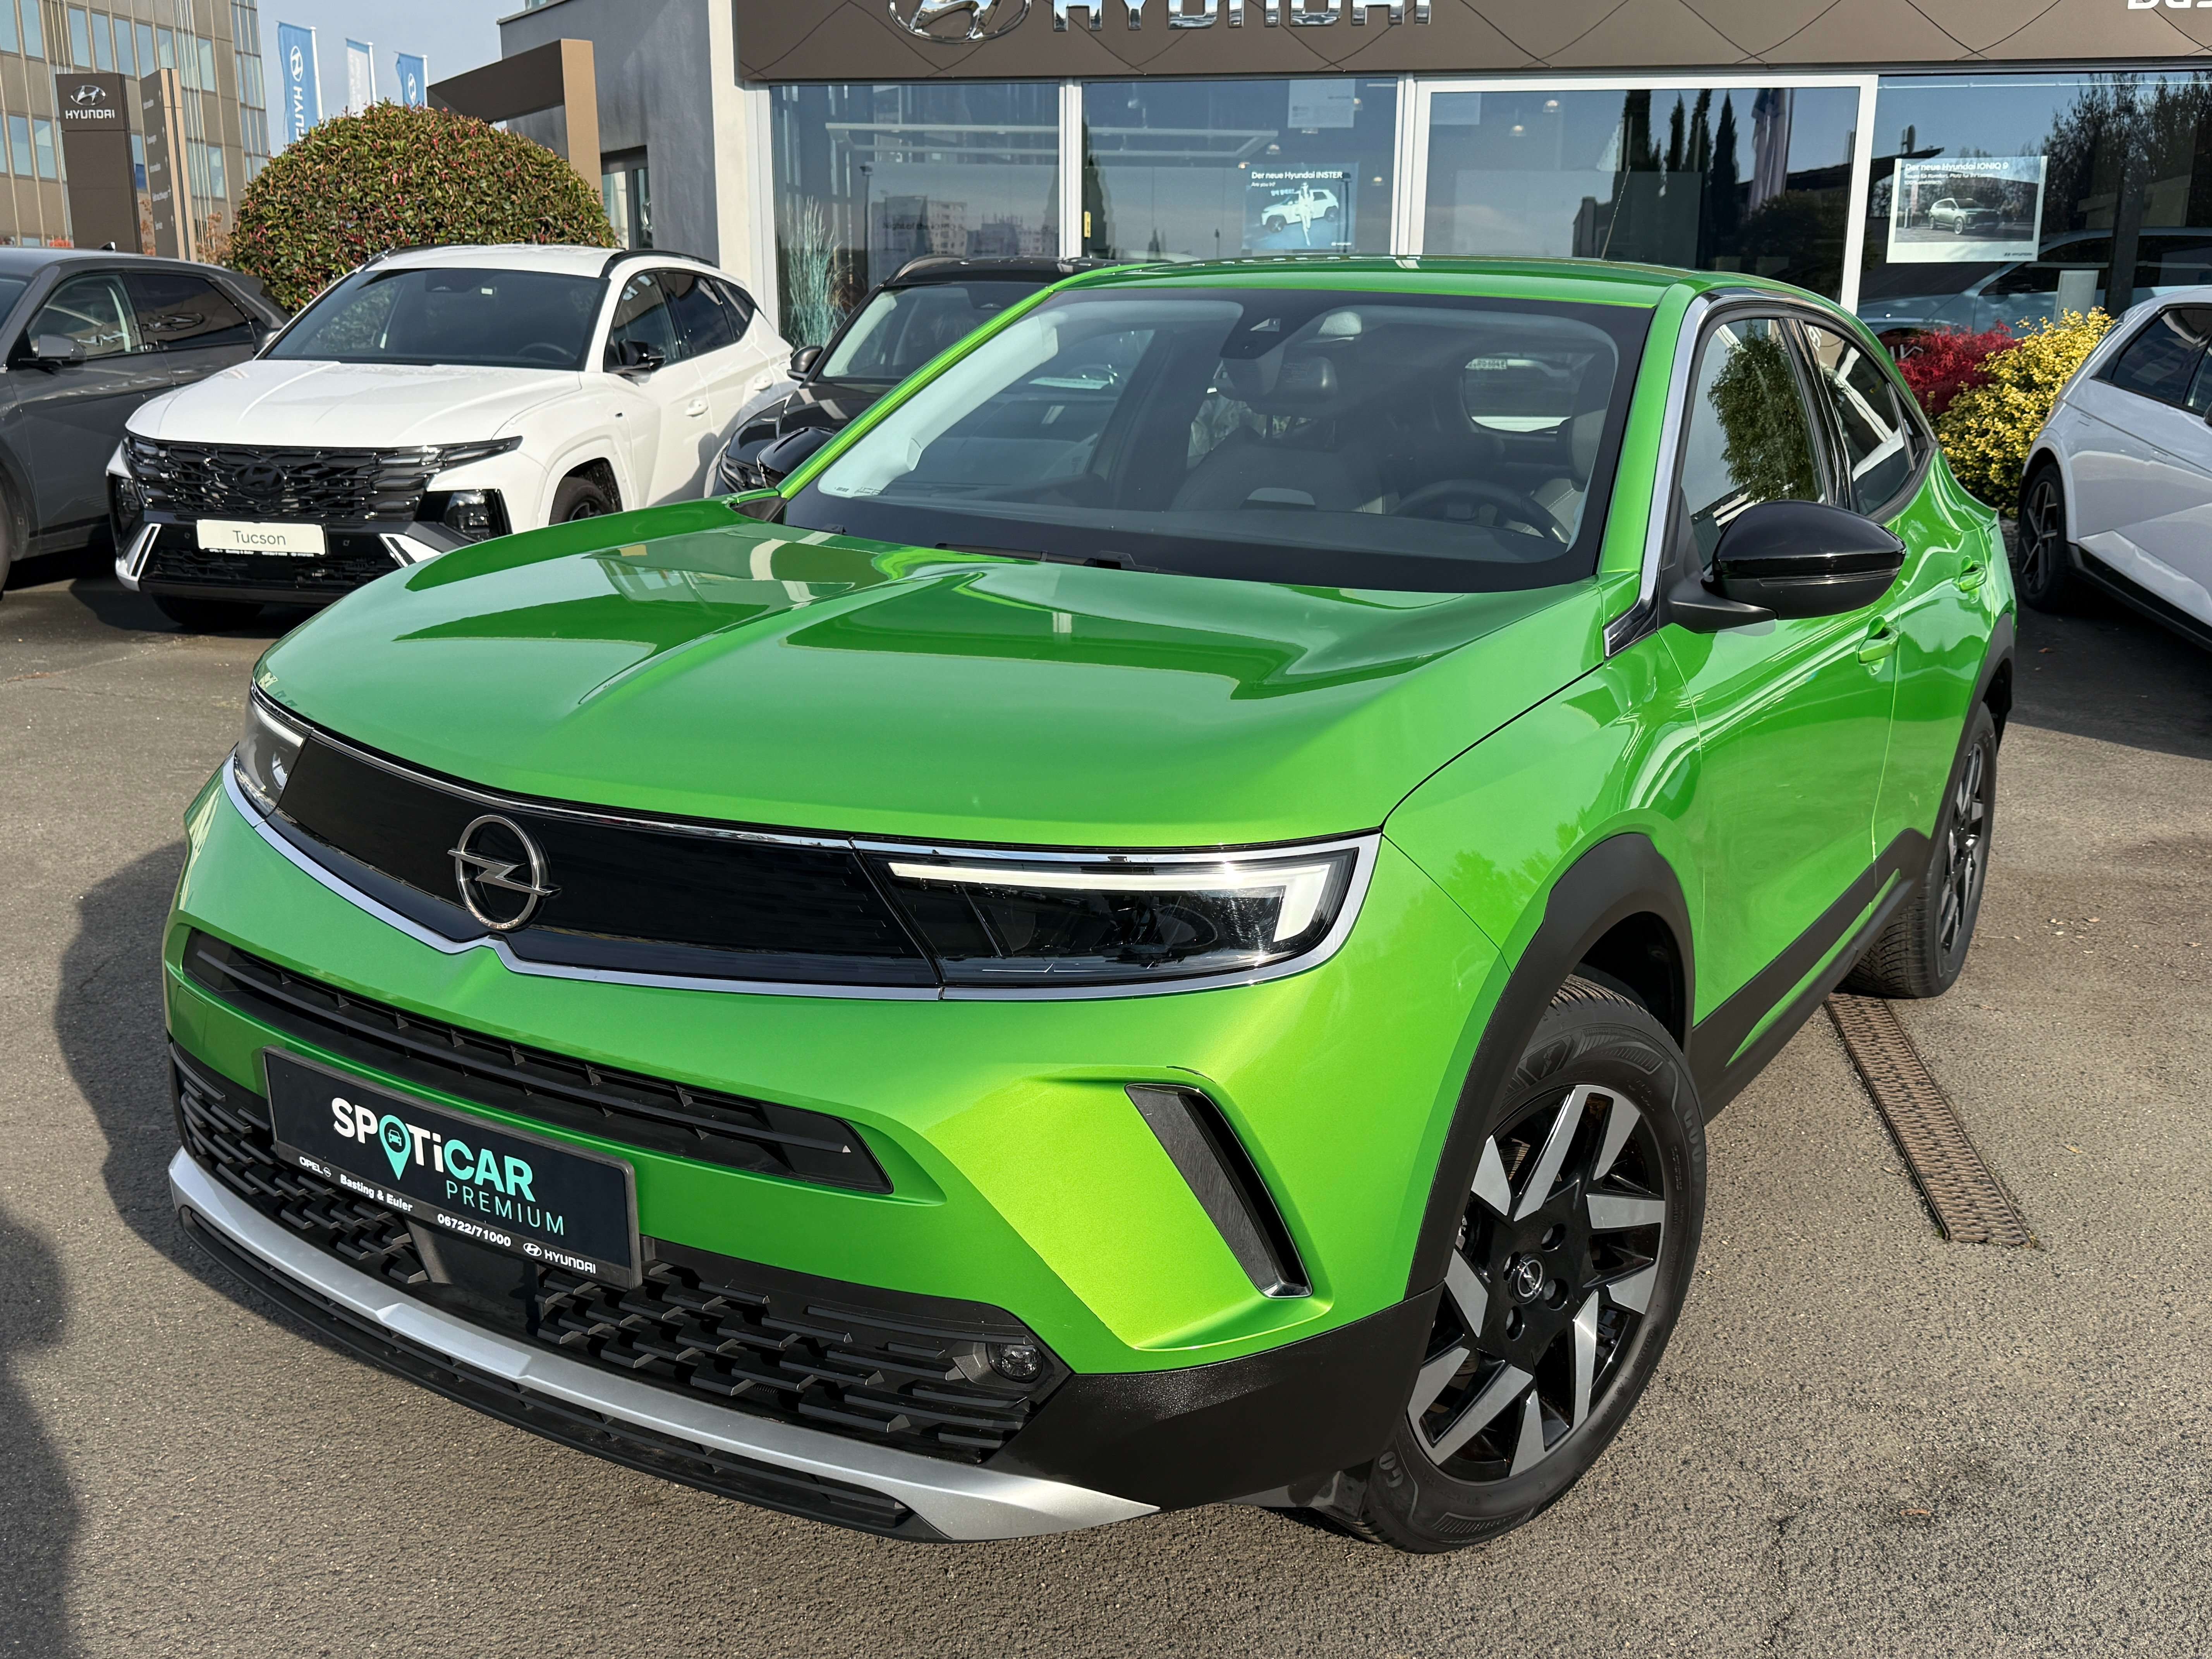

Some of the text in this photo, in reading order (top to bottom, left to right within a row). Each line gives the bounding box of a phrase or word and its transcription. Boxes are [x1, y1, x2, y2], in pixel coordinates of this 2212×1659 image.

[65, 109, 115, 119] HYUNDAI
[1942, 163, 1976, 172] Hyundai
[1285, 172, 1315, 180] Hyundai
[232, 530, 286, 545] Tucson
[446, 1180, 564, 1236] PREMIUM
[299, 1156, 596, 1274] OPEL Basting & Euler 06722/71000 HYUNDAI
